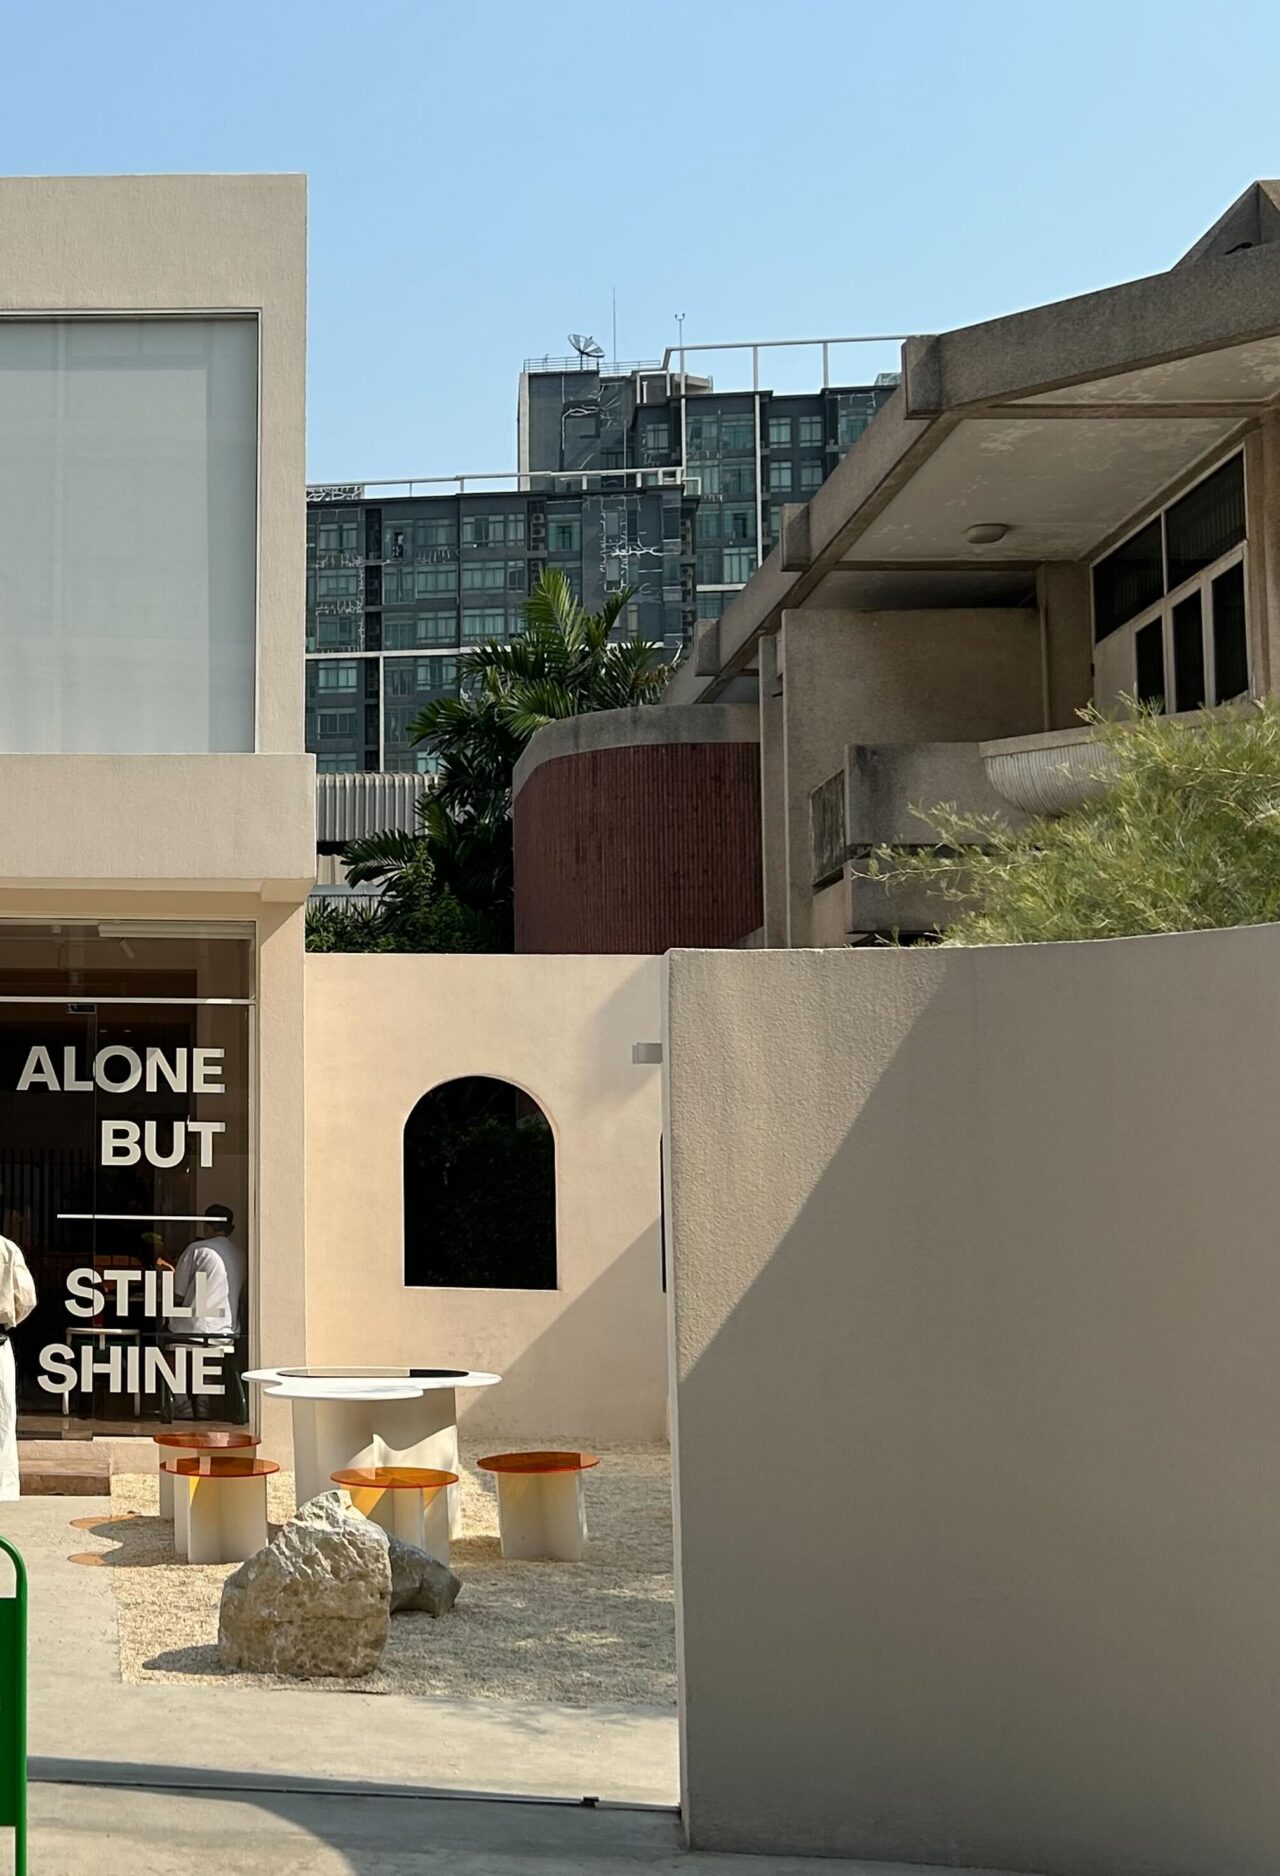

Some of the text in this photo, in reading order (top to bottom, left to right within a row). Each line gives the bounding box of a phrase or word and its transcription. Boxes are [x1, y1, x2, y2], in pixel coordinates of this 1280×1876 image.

[15, 1045, 226, 1094] ALONE
[100, 1119, 226, 1168] BUT
[64, 1268, 226, 1318] STILL
[37, 1343, 226, 1396] SHINE
